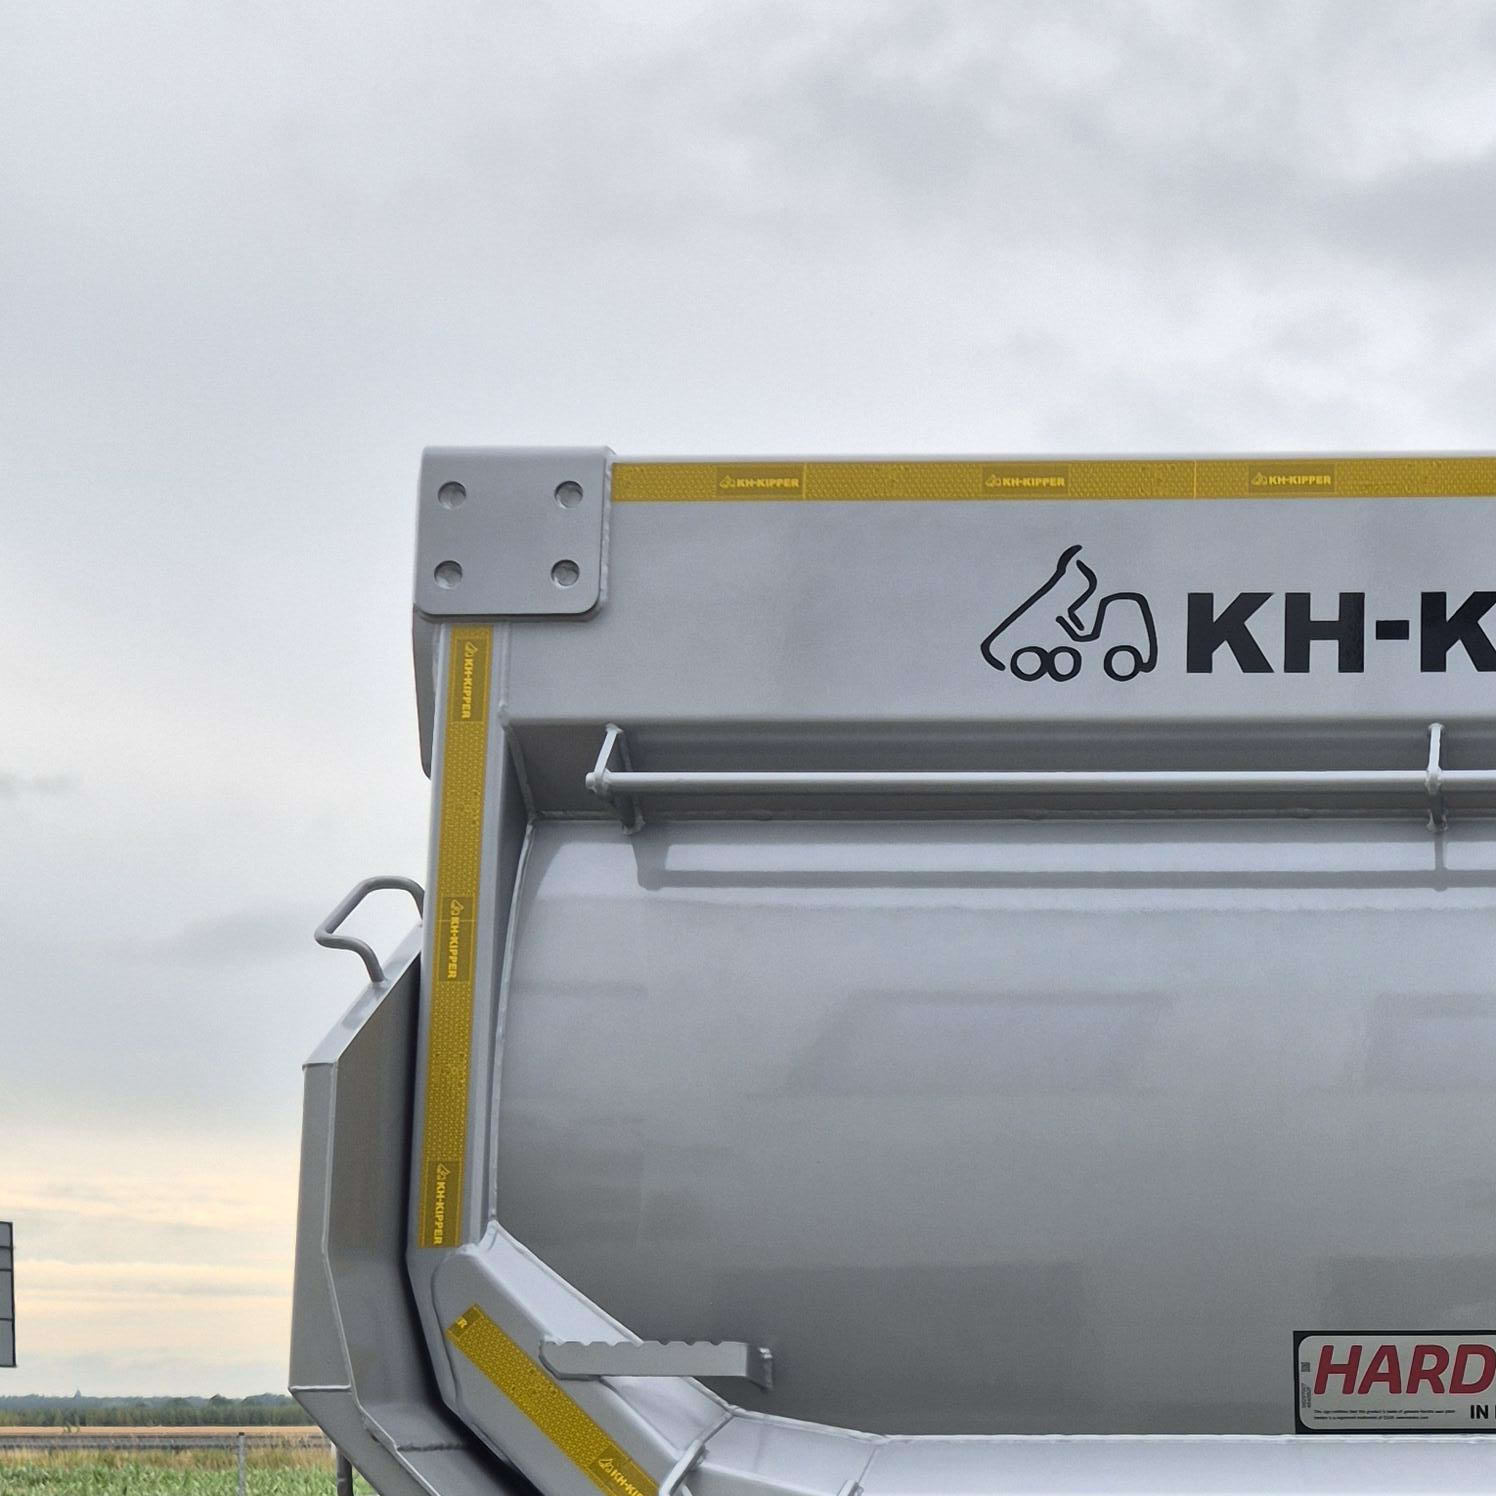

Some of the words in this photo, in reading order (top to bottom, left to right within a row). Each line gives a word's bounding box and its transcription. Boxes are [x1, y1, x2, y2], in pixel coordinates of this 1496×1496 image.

[737, 478, 799, 488] KH-KIPPER
[1003, 477, 1066, 487] KH-KIPPER
[1269, 475, 1331, 485] KH-KIPPER
[461, 659, 474, 719] KH-KIPPER
[447, 917, 460, 979] KH-KIPPER
[434, 1181, 446, 1245] KH-KIPPER
[1470, 1404, 1489, 1420] IN
